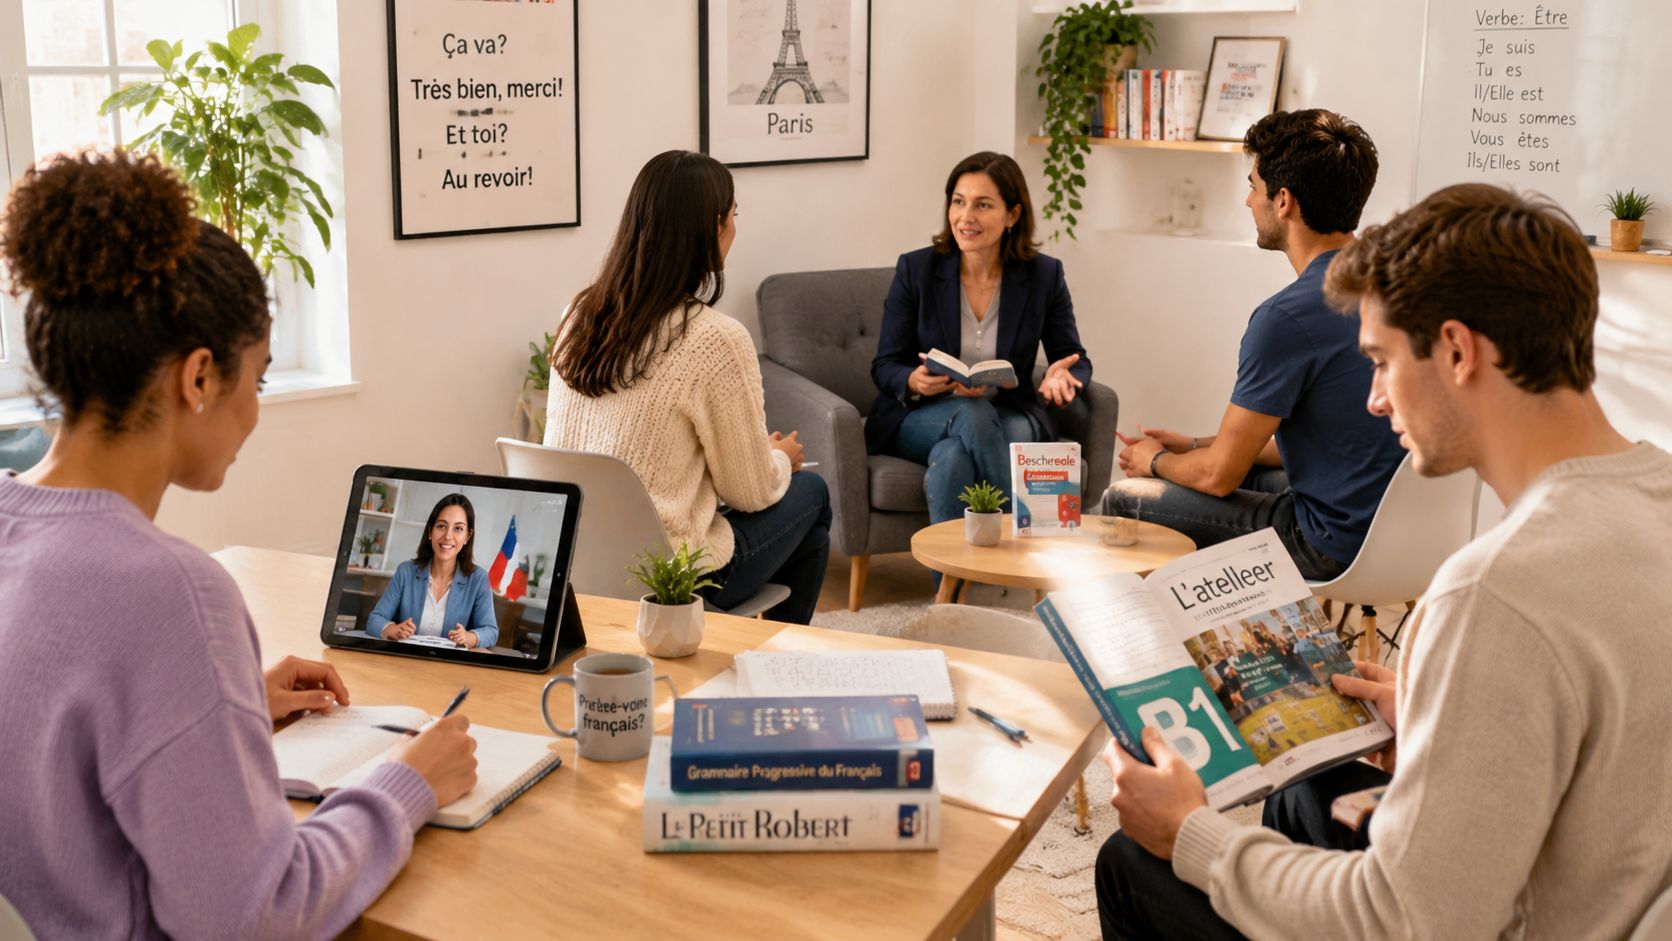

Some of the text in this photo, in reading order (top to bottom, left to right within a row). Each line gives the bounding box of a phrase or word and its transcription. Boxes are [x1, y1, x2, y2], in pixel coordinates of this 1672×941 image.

[1476, 4, 1568, 26] Verbe: Être
[442, 33, 508, 59] Ça va?
[1476, 38, 1536, 58] Je suis
[1475, 61, 1522, 77] Tu es
[410, 77, 563, 101] Très bien, merci!
[1520, 86, 1544, 101] est
[767, 112, 814, 135] Paris
[1471, 106, 1577, 126] Nous sommes
[446, 123, 508, 145] Et toi?
[1470, 129, 1504, 146] Vous
[1528, 158, 1561, 173] sont
[441, 166, 533, 190] Au revoir!
[583, 712, 646, 738] français?
[1137, 686, 1242, 773] B1
[687, 764, 750, 780] Grammaire
[818, 764, 834, 778] du
[835, 763, 883, 782] Français
